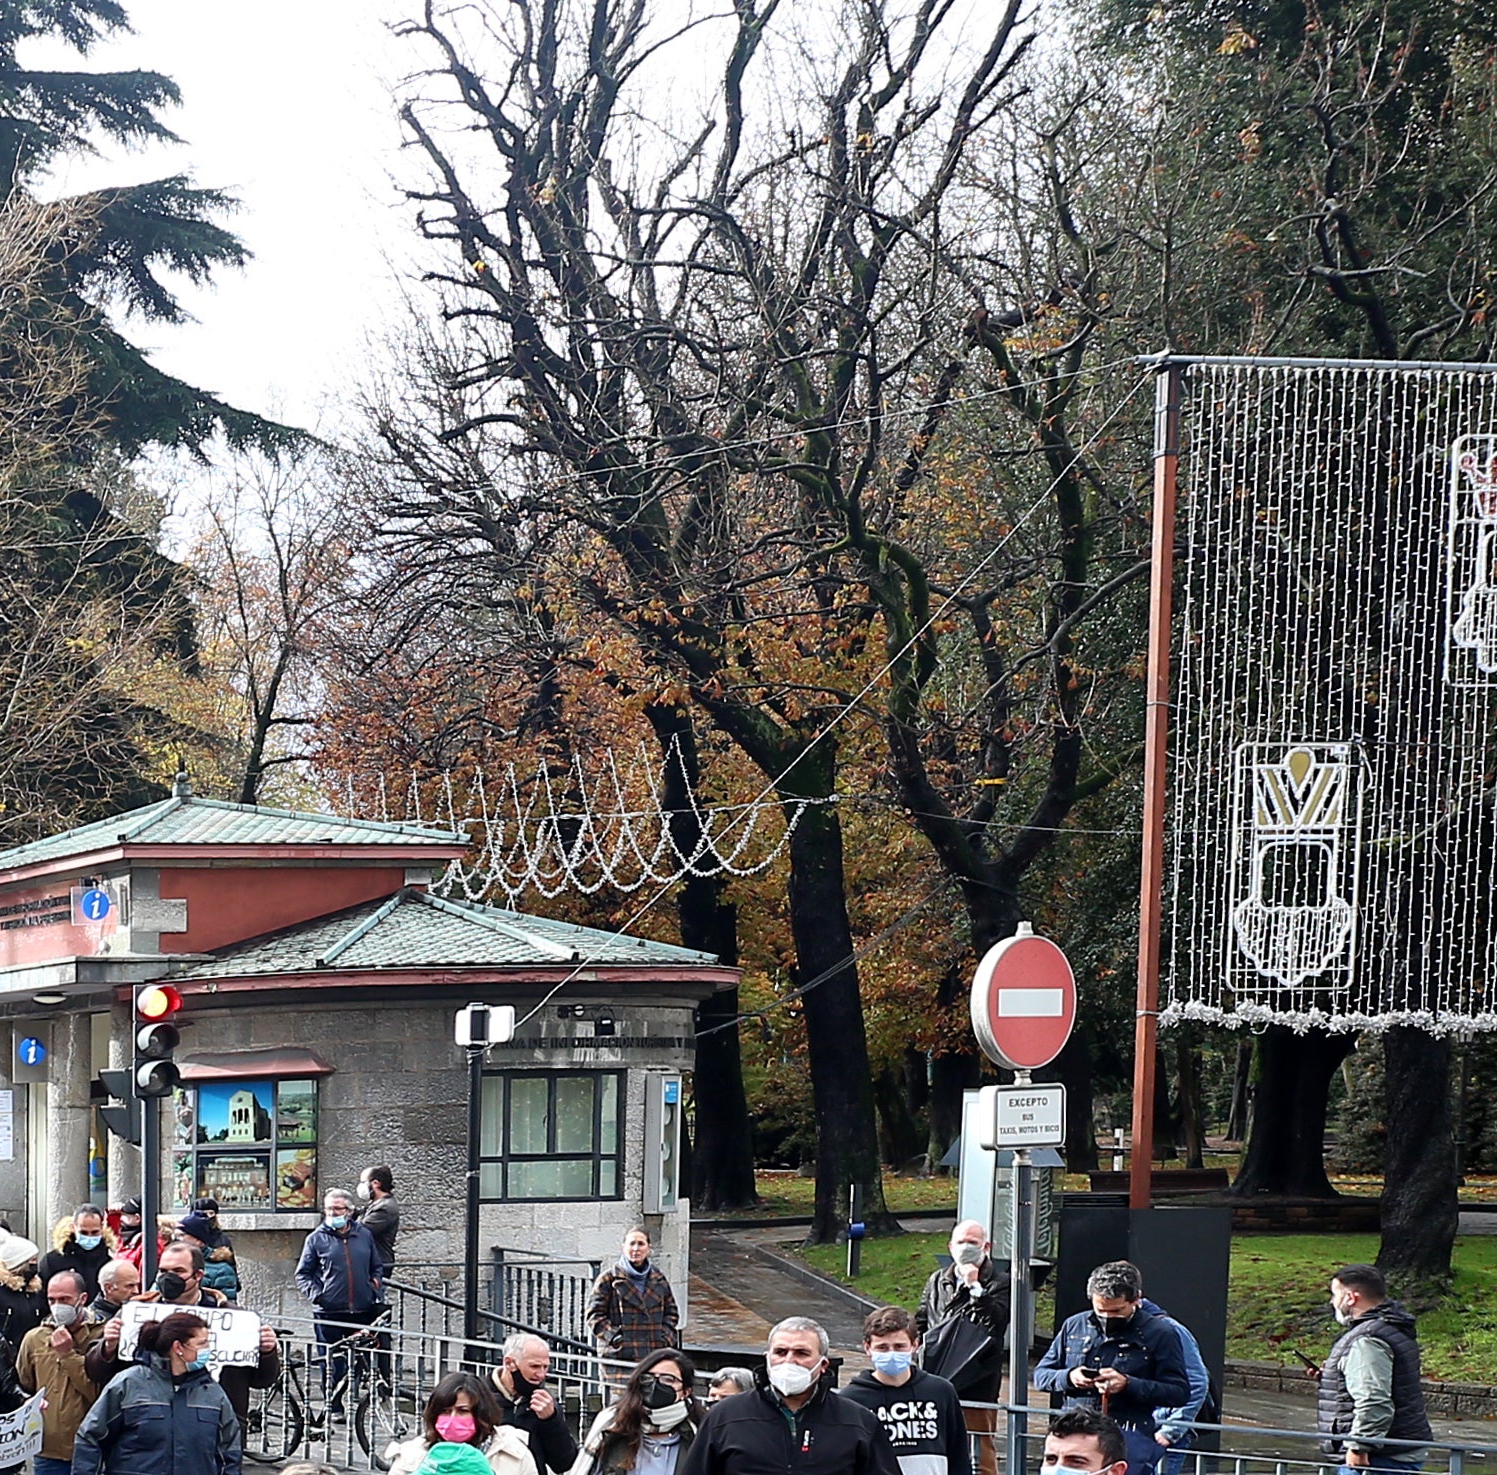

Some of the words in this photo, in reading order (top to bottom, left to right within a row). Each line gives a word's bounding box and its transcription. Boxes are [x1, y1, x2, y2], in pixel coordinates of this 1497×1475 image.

[1008, 1097, 1049, 1108] EXCEPTO
[1022, 1113, 1034, 1121] BUS
[877, 1401, 938, 1422] ACK&
[884, 1420, 938, 1441] ONES
